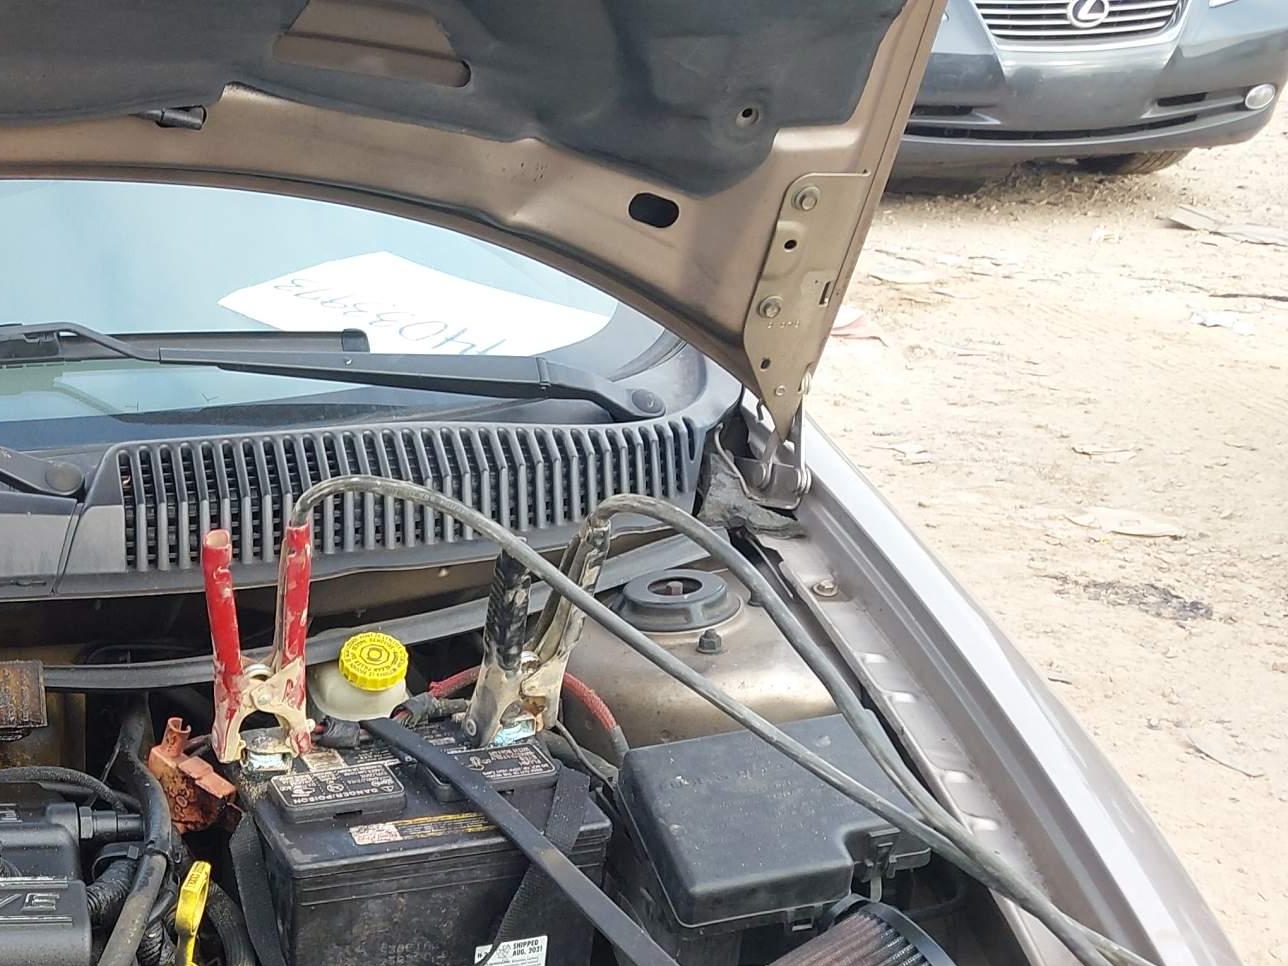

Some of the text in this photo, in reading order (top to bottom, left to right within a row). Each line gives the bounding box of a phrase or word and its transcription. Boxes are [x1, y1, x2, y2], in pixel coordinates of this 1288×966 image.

[293, 788, 379, 804] DANGER/POISON
[512, 939, 539, 950] SHIPPED
[512, 948, 527, 957] AUG.
